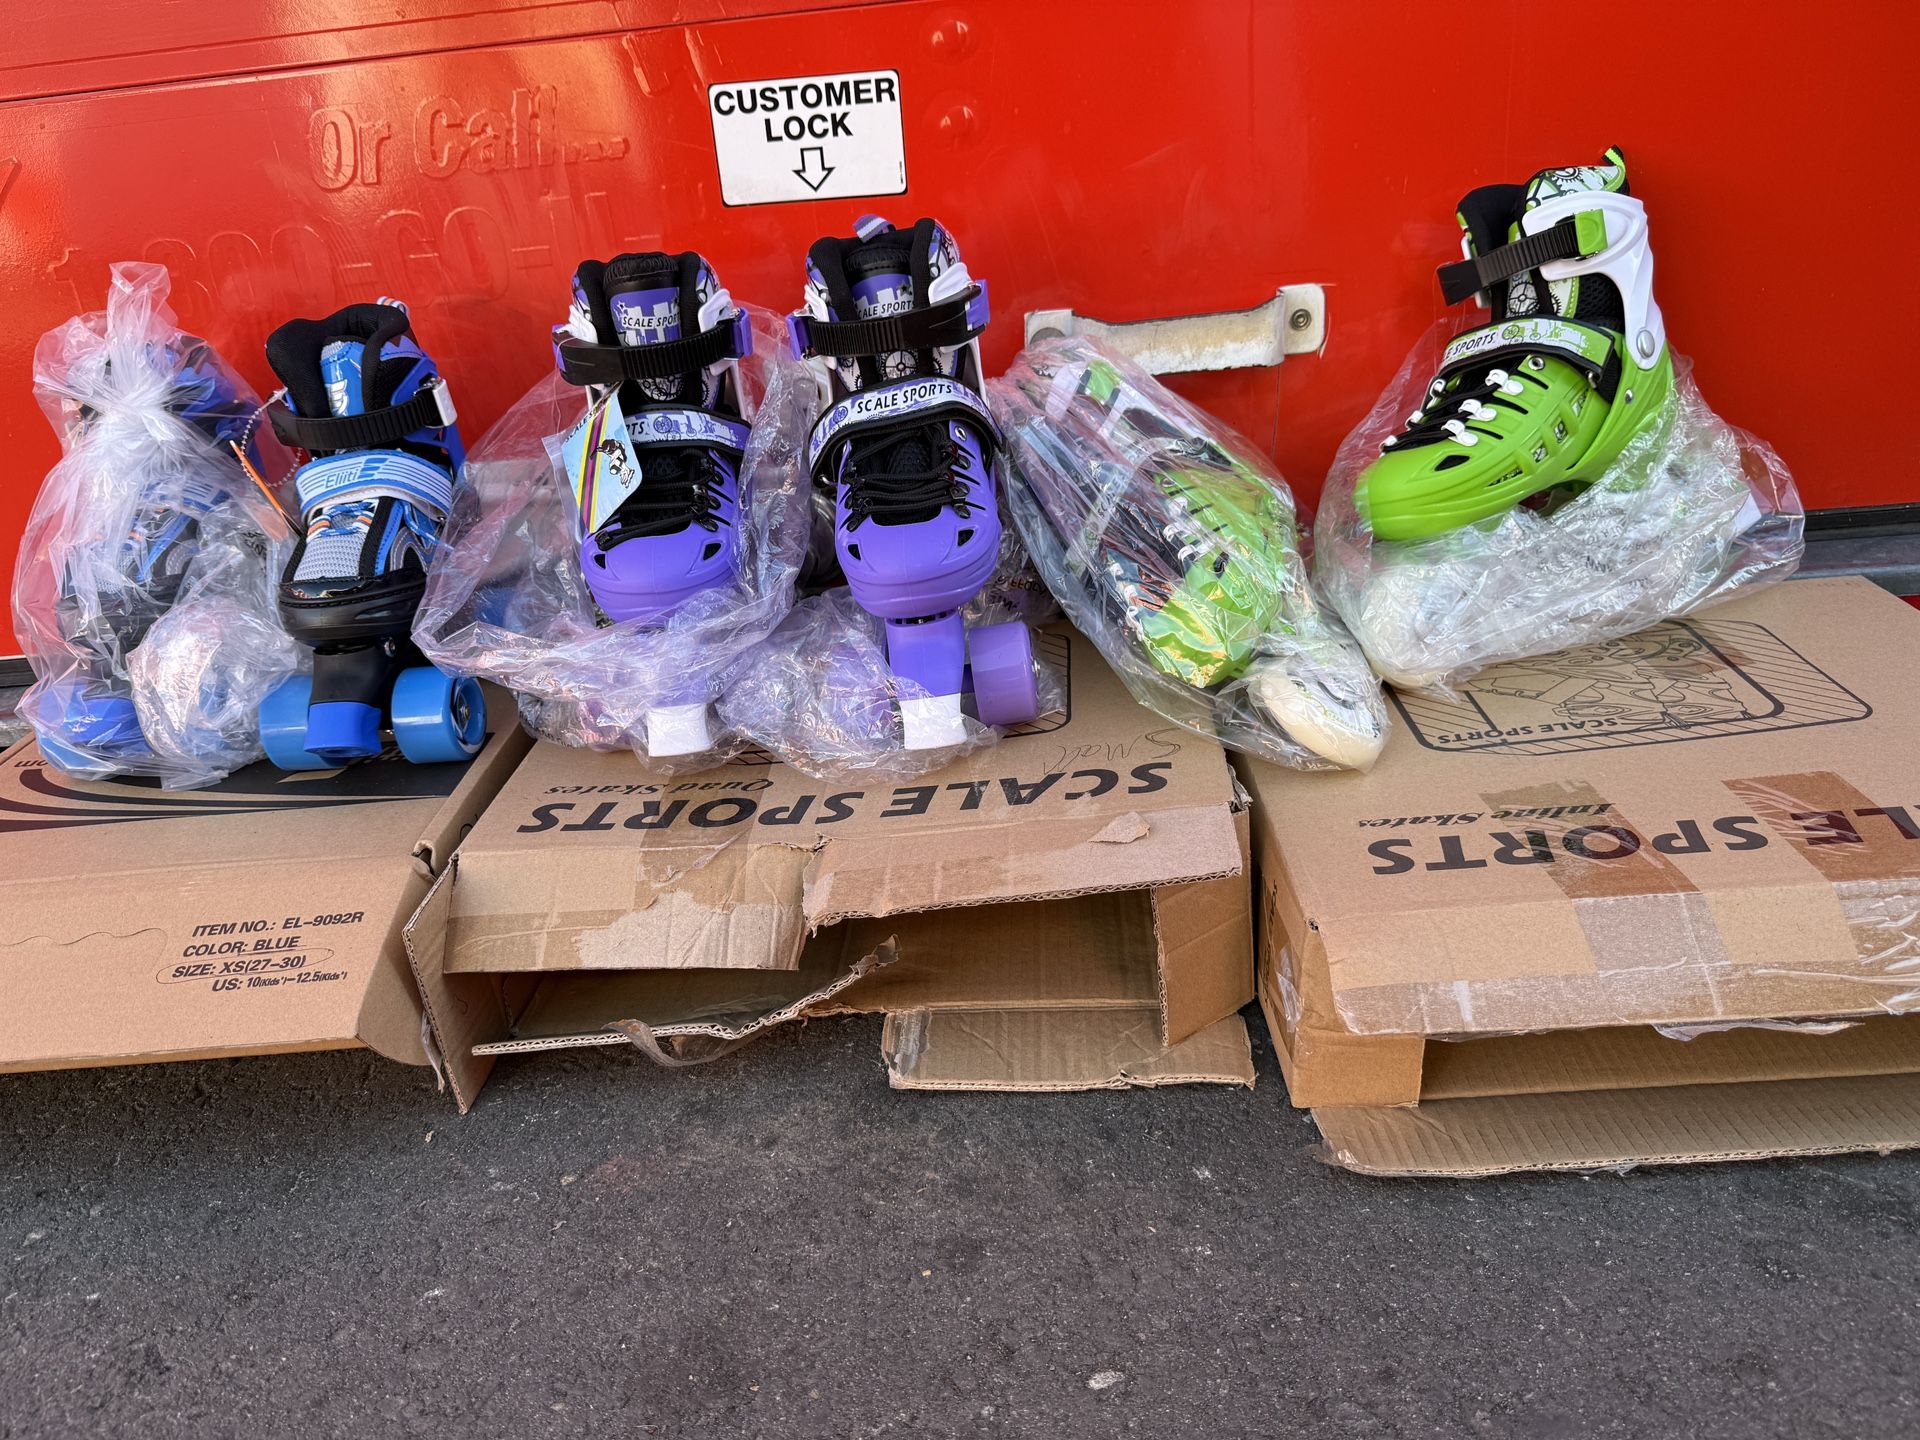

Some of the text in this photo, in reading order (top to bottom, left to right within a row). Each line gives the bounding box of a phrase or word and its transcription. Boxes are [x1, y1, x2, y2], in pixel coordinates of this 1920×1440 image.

[713, 77, 896, 116] CUSTOMER
[764, 111, 853, 142] LOCK
[310, 106, 391, 191] Or
[623, 316, 653, 328] SCALE
[1453, 332, 1496, 355] SPORTS
[857, 383, 952, 414] SCALE SPORTS
[1437, 717, 1619, 745] SCALE SPORTS
[544, 778, 774, 795] Quad Skates
[880, 761, 1173, 818] SCALE
[516, 790, 865, 833] SPORTS
[1358, 803, 1617, 829] Inline Skates
[1367, 816, 1769, 875] SPORTS
[192, 911, 364, 938] ITEM NO.: EL-9092R
[183, 936, 302, 957] COLOR: BLUE
[172, 955, 307, 978] SIZE: XS(27-30)
[211, 978, 244, 992] US:
